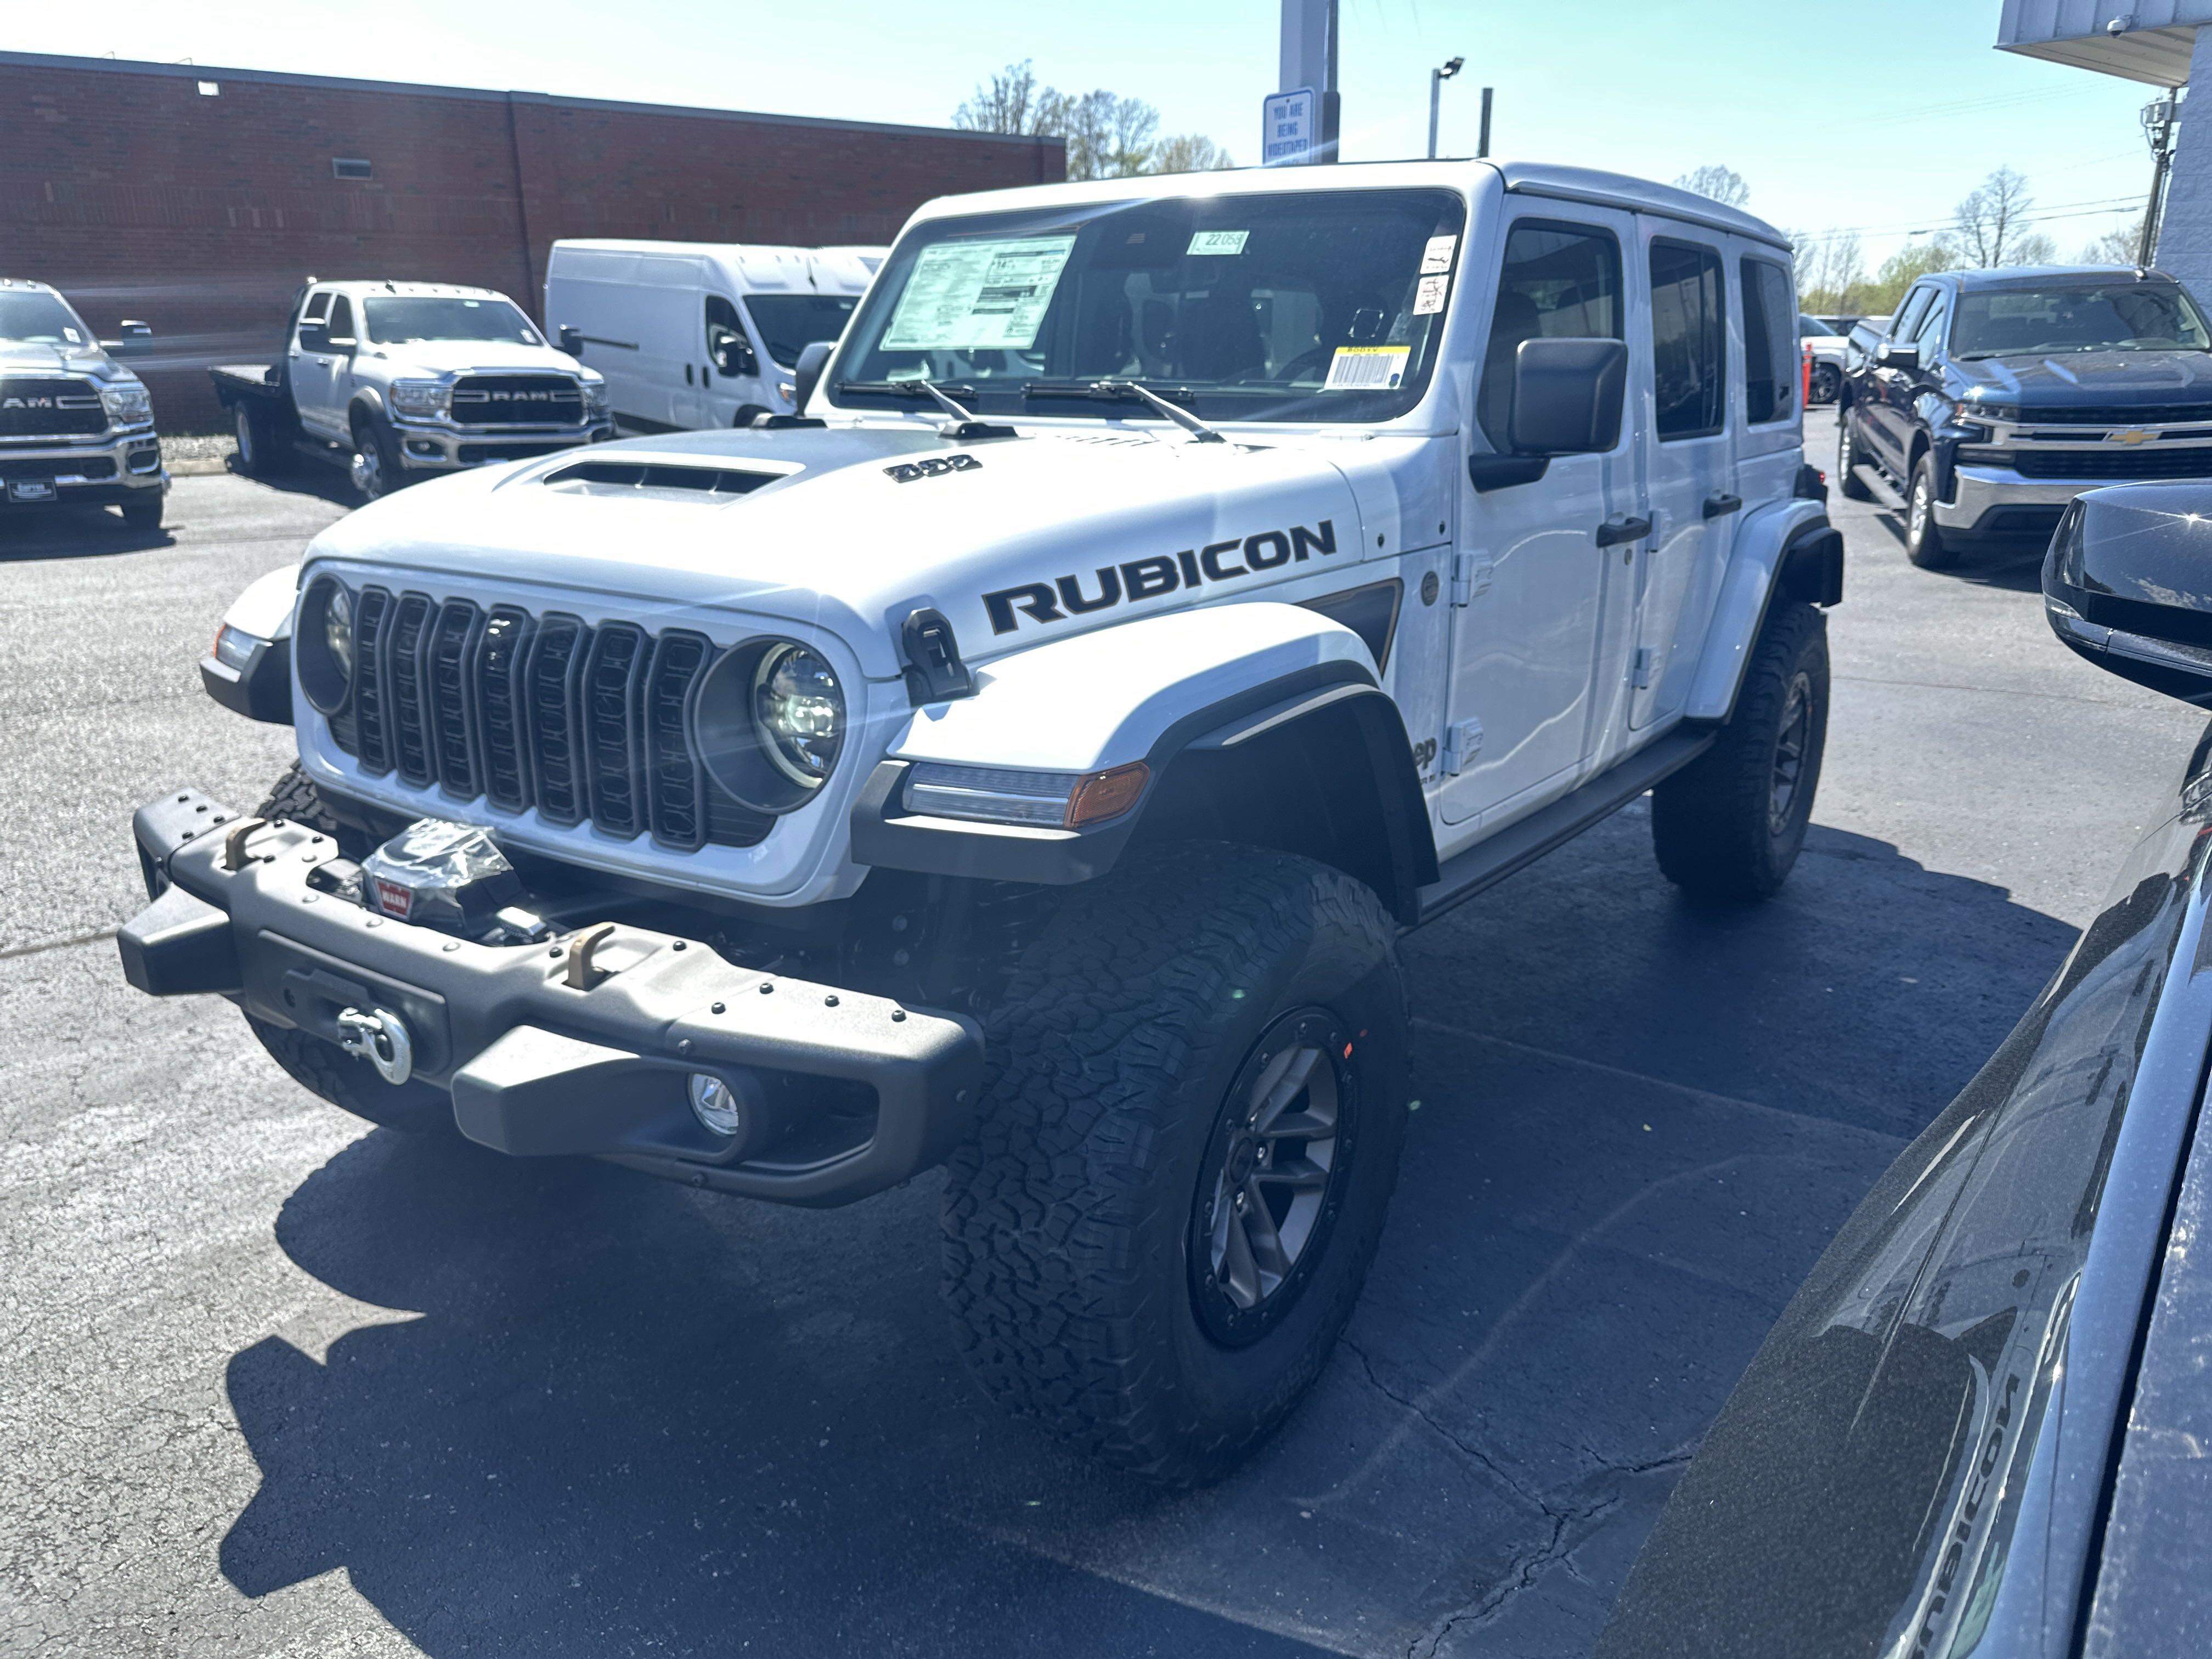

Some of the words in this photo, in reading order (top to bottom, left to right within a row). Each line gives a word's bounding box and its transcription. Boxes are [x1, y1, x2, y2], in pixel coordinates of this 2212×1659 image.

[1273, 105, 1287, 120] YOU
[1277, 122, 1298, 138] BEING
[2, 397, 53, 409] AM
[493, 391, 549, 402] RAM
[981, 520, 1337, 635] RUBICON
[1413, 737, 1437, 770] ep
[382, 889, 407, 909] WARN
